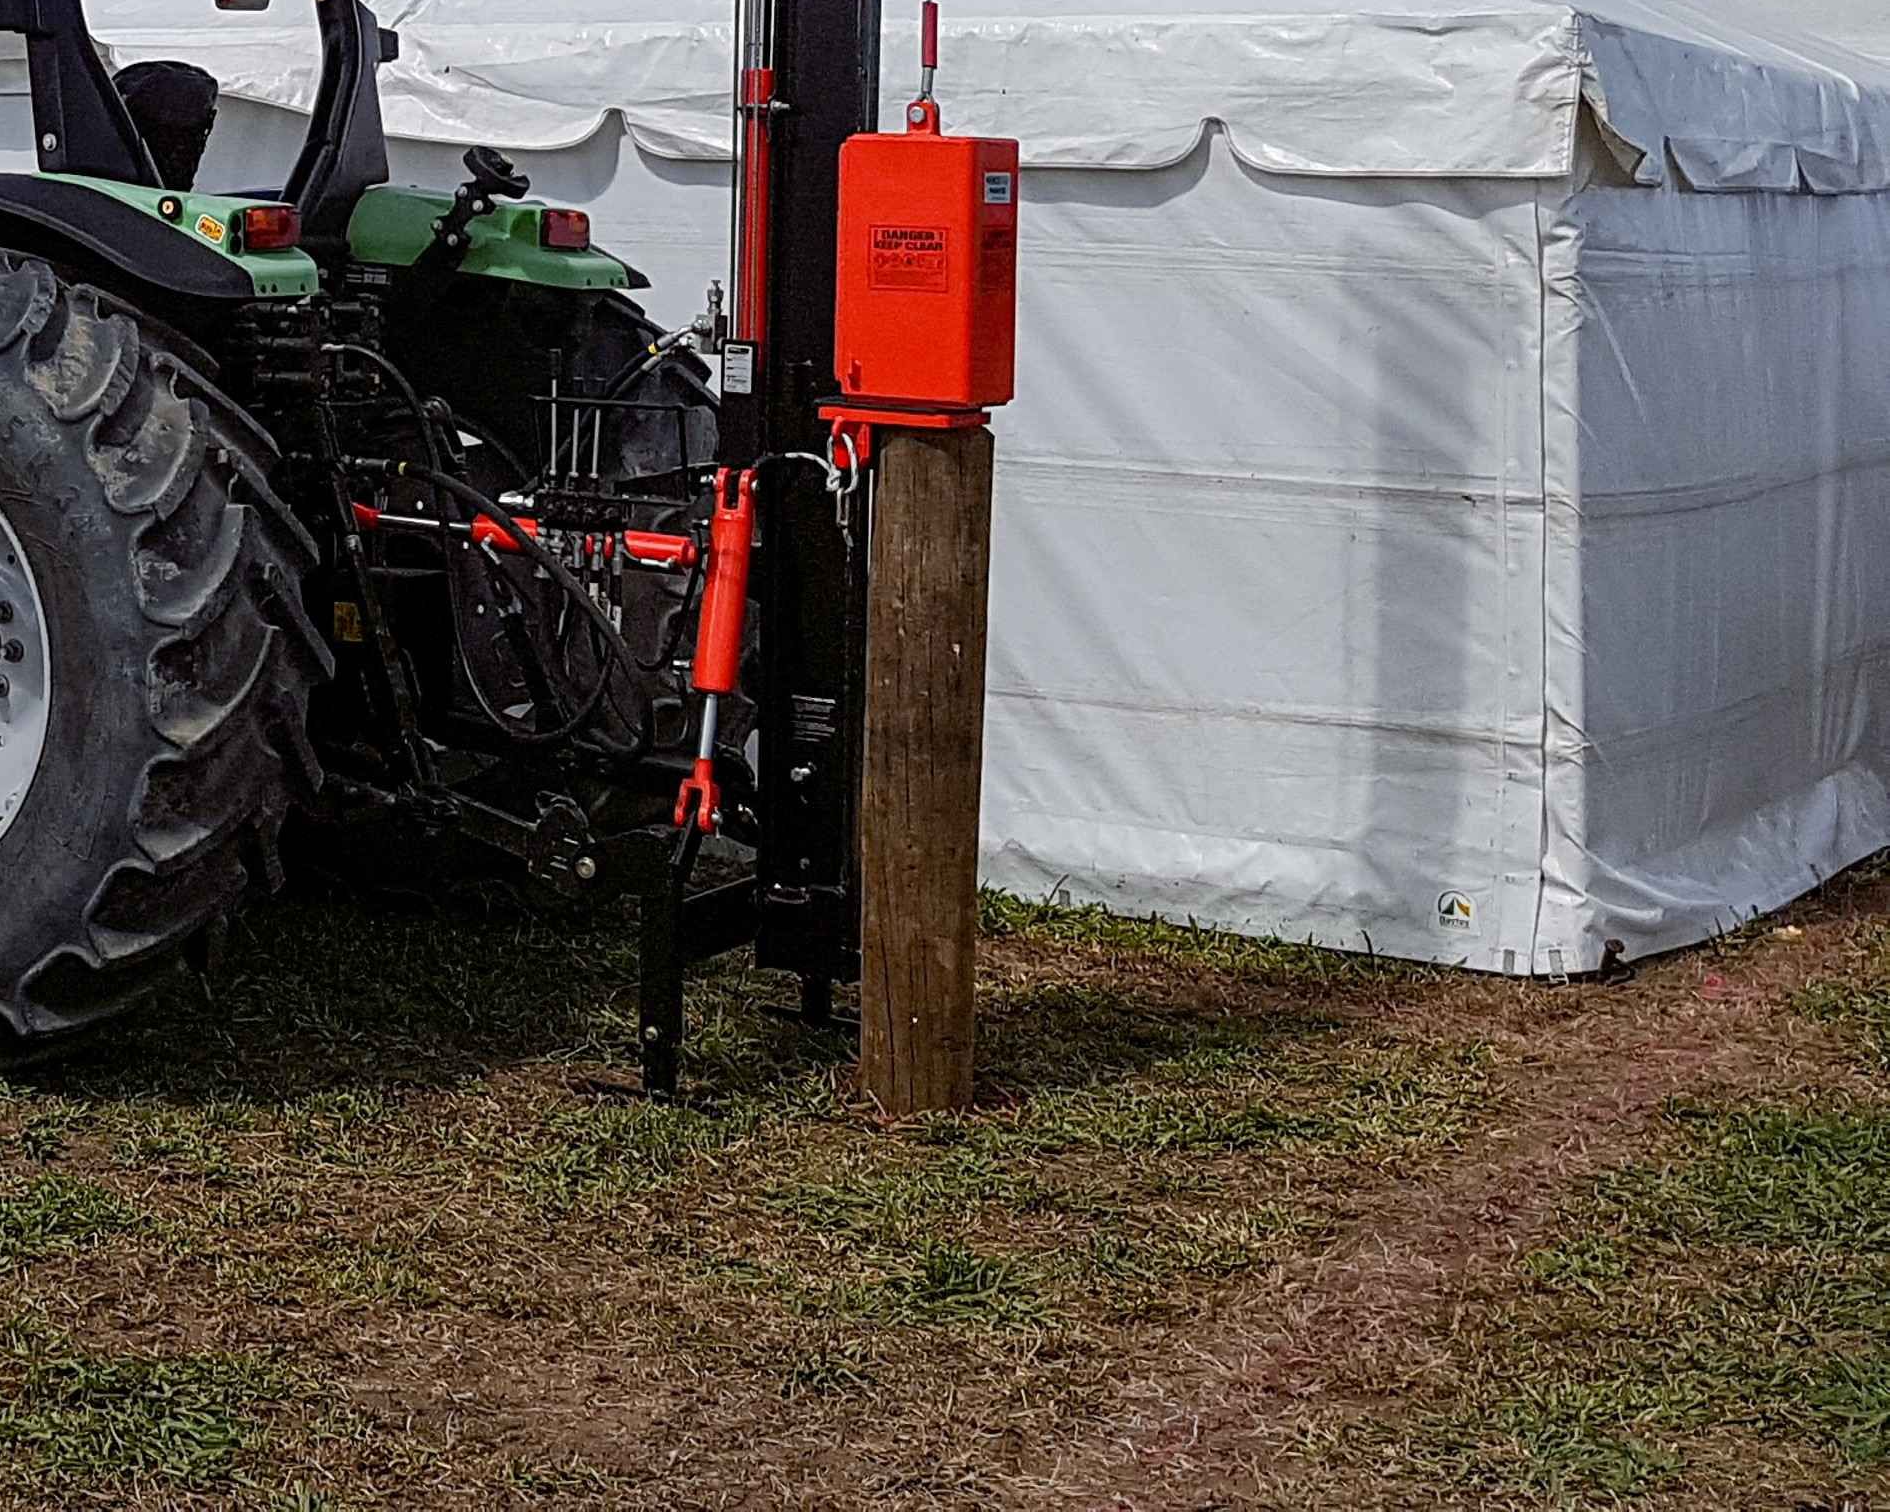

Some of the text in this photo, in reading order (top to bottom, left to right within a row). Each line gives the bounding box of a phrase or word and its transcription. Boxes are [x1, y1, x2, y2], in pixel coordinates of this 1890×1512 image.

[881, 230, 935, 241] DANGER
[873, 240, 943, 252] KEEP CLEAR
